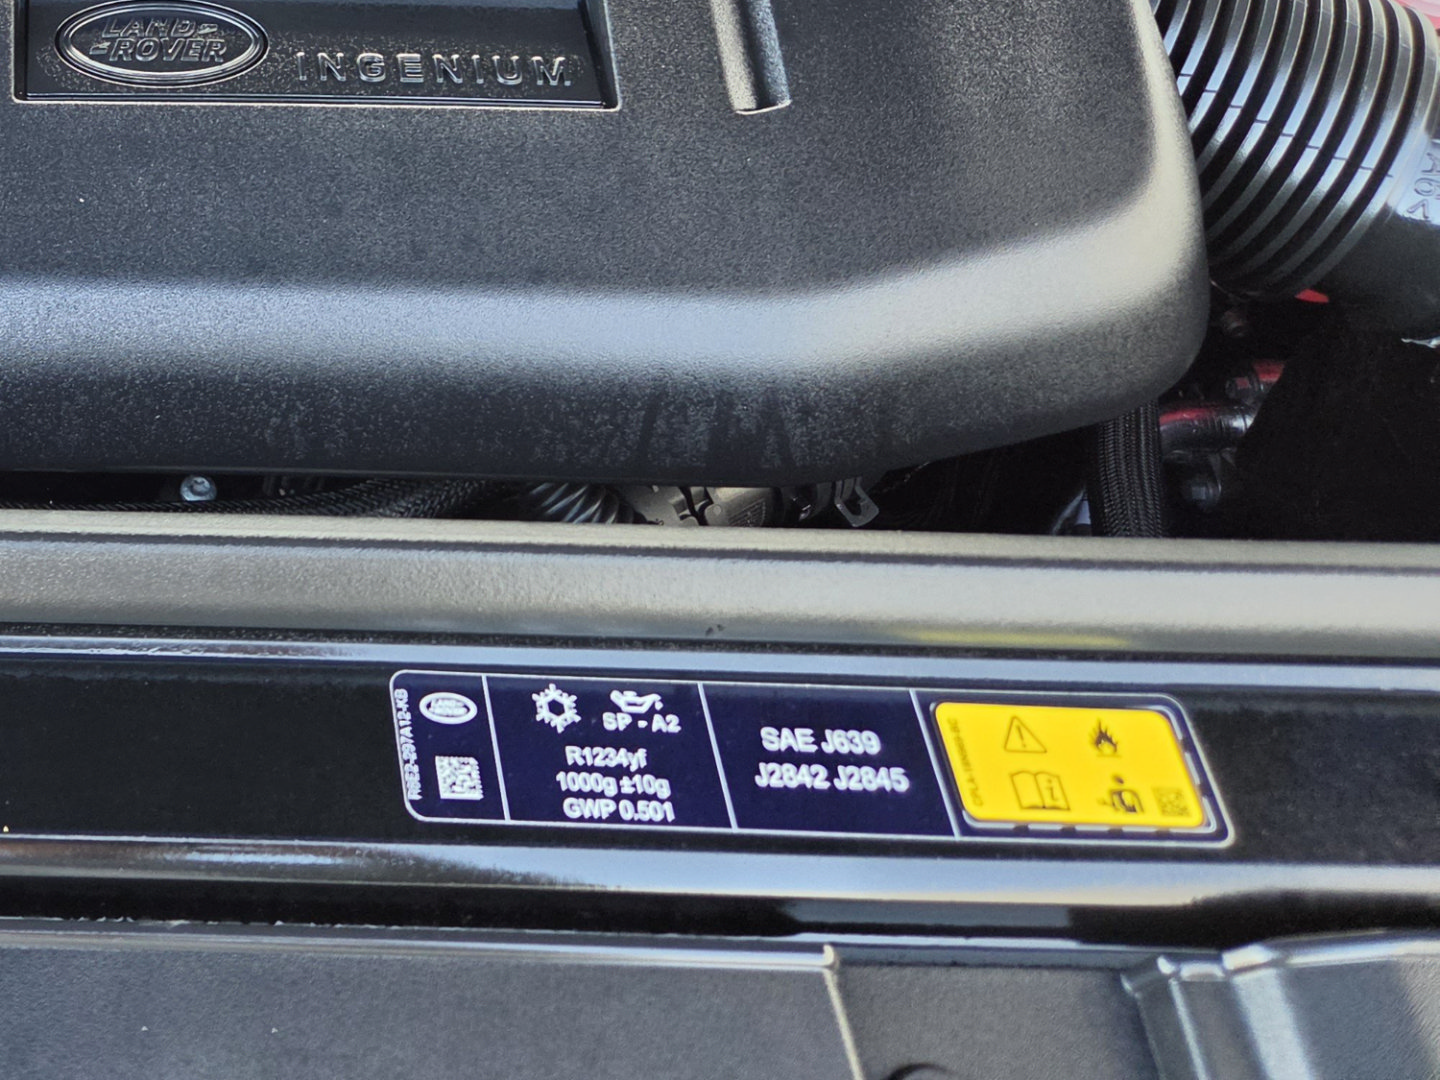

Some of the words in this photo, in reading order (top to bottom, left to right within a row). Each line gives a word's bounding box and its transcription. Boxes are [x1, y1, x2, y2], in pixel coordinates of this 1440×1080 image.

[101, 18, 196, 38] LAND
[109, 37, 228, 63] ROVER
[295, 51, 572, 86] INGENIUM
[602, 712, 633, 731] SP
[651, 714, 682, 733] A2
[760, 727, 818, 752] SAE
[821, 729, 881, 755] J639
[565, 746, 647, 772] R1234yf
[556, 771, 618, 797] 1000g
[620, 774, 671, 799] ±10g
[755, 762, 831, 789] J2842
[833, 765, 910, 792] J2845
[563, 797, 617, 819] GWP
[618, 800, 675, 822] 0.501
